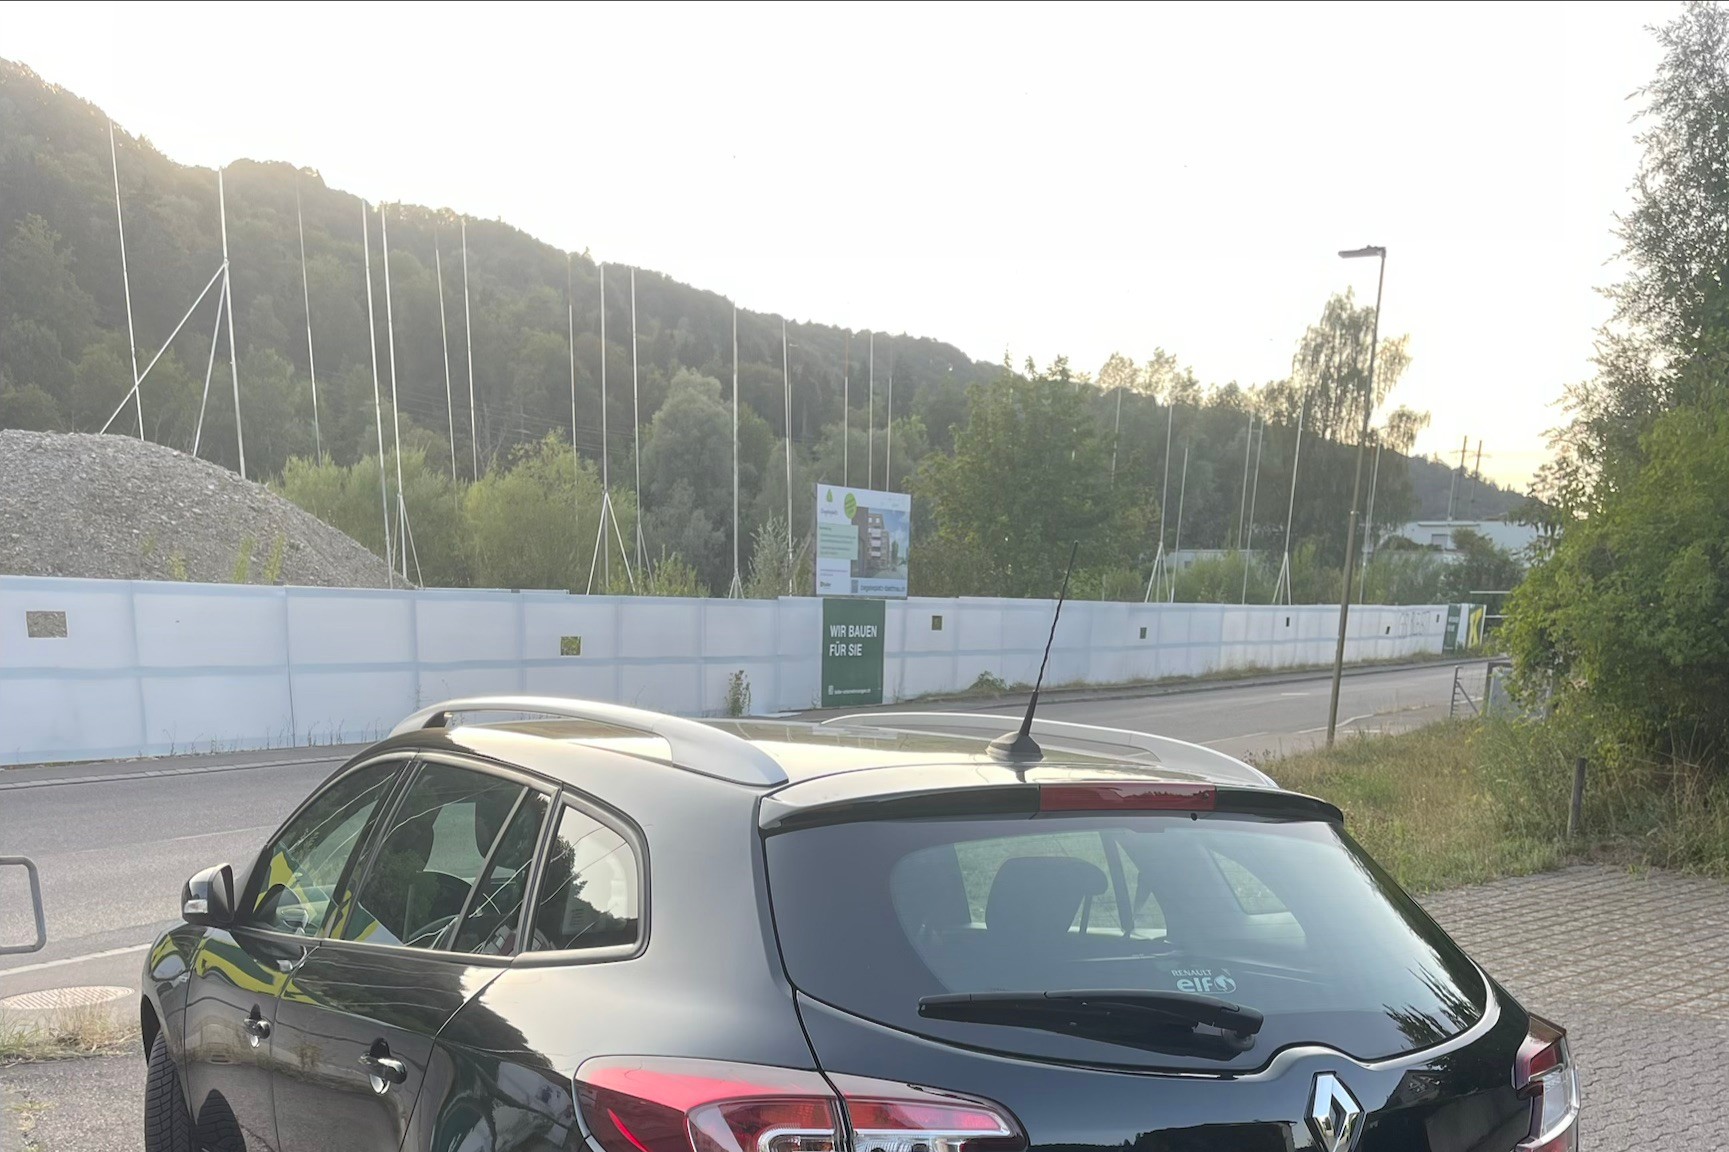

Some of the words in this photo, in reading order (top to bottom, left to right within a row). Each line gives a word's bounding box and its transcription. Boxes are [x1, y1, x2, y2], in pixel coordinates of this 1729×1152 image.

[829, 625, 847, 637] WIR
[848, 625, 878, 638] BAUEN
[829, 641, 847, 656] FÜR
[848, 644, 863, 656] SIE
[1171, 969, 1212, 977] RENAULT
[1176, 977, 1213, 992] elf
